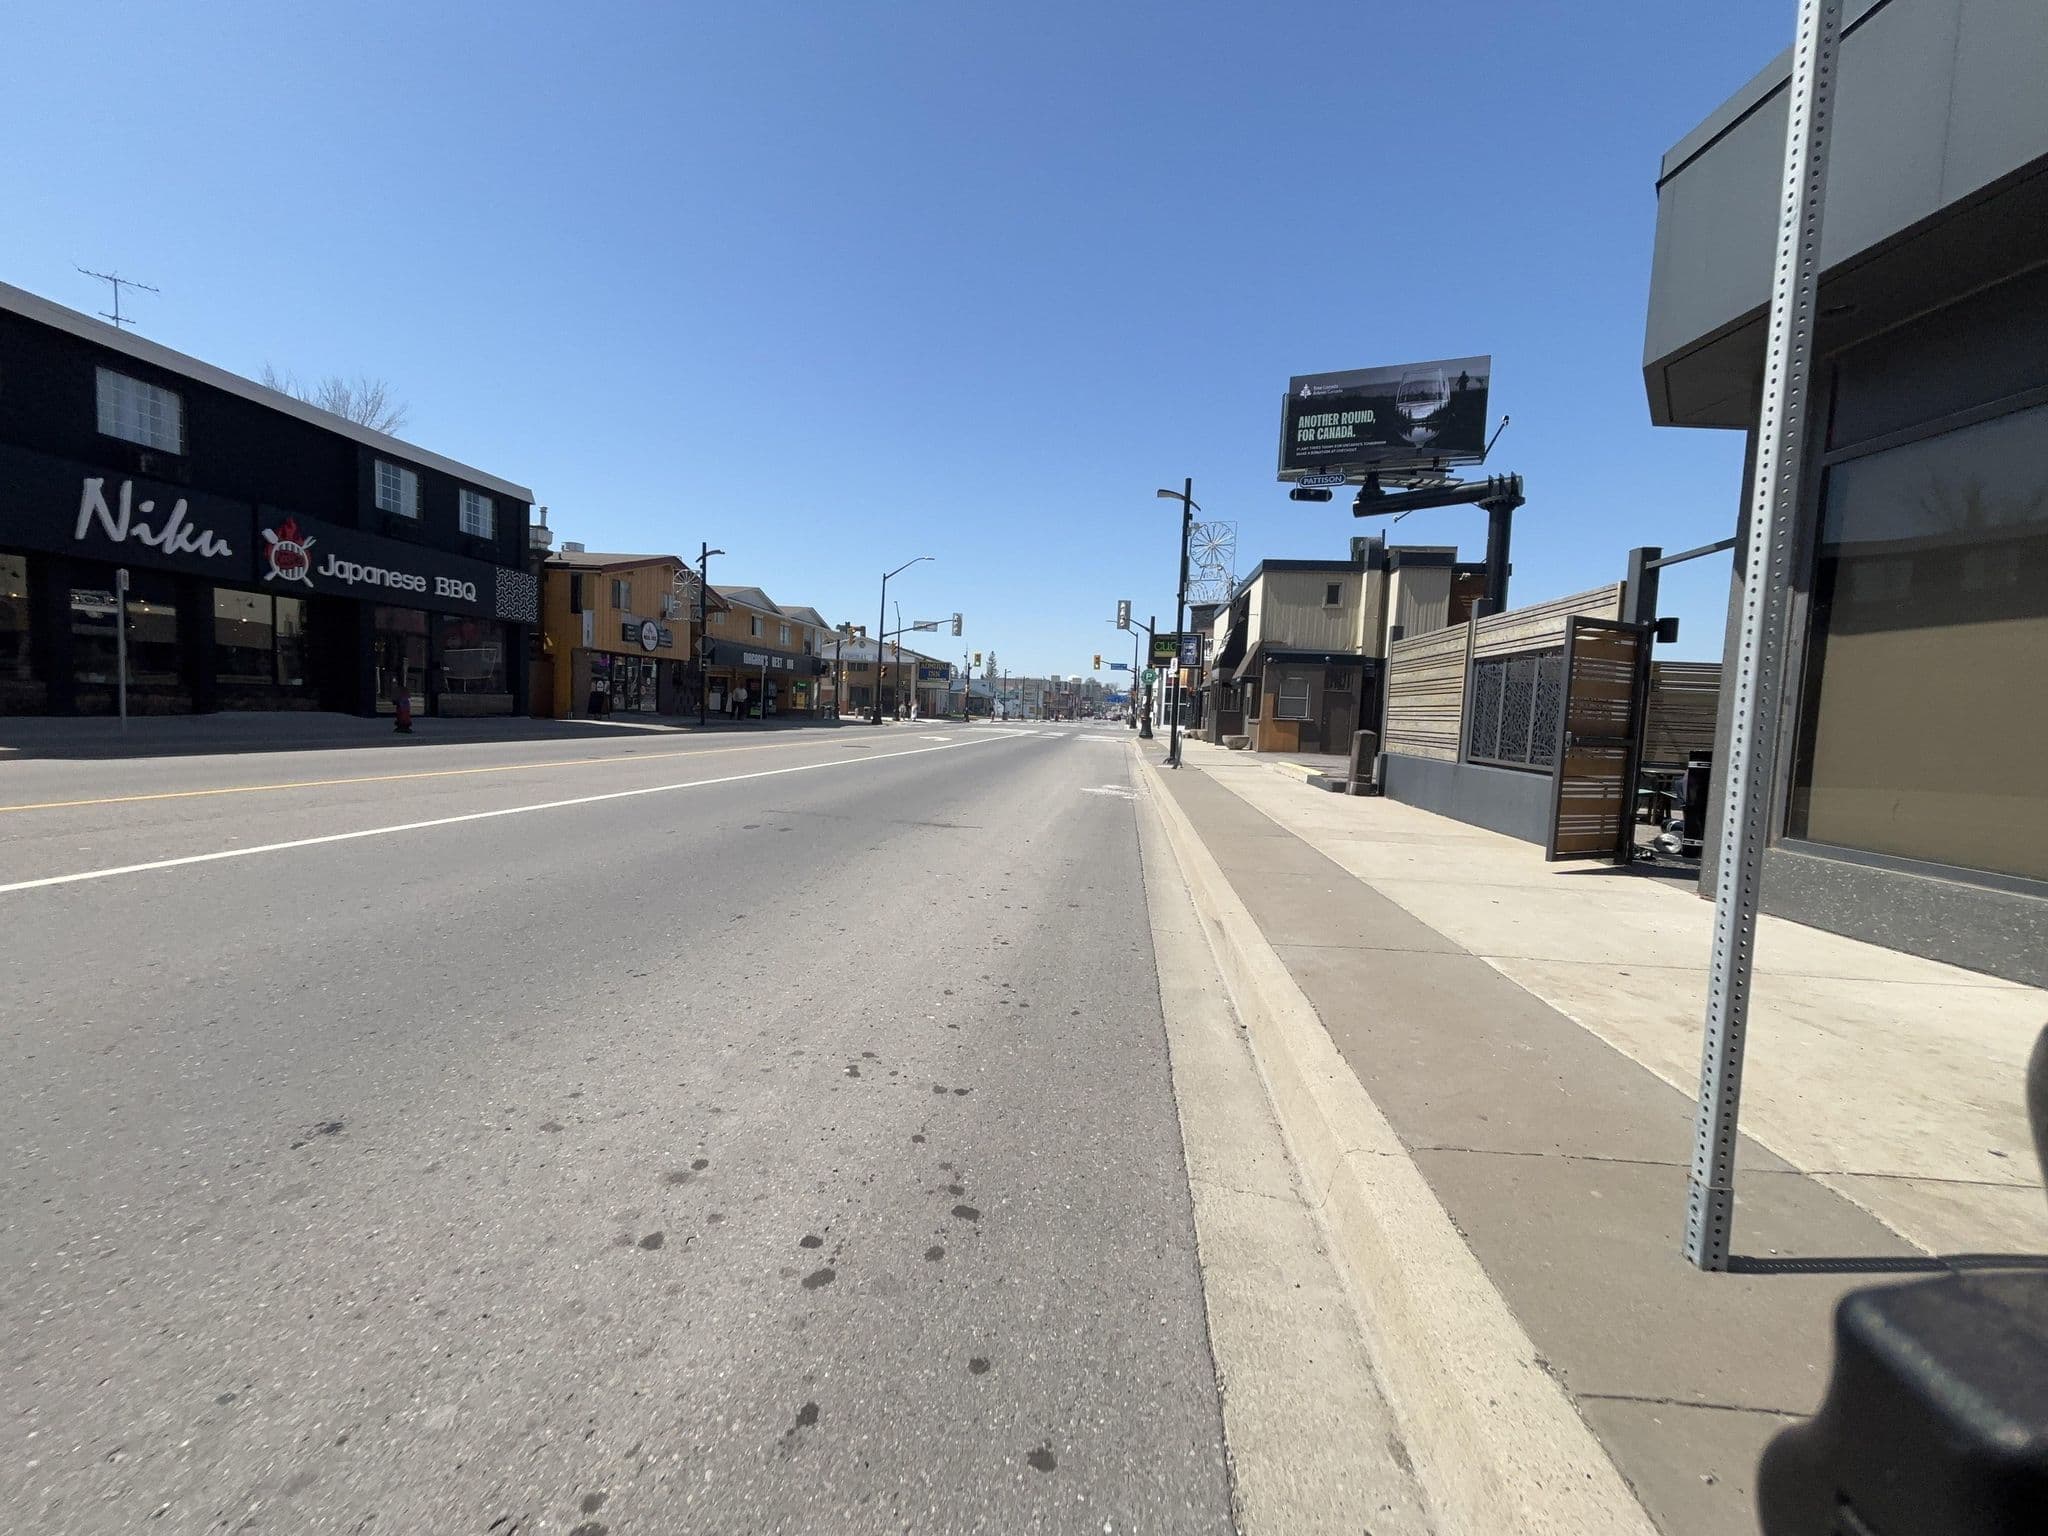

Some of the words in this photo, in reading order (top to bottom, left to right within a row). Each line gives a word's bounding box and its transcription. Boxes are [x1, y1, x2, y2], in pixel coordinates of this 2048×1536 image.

[1298, 413, 1339, 428] ANOTHER
[1341, 410, 1376, 425] ROUND,
[1297, 428, 1315, 442] FOR
[1317, 425, 1356, 440] CANADA.
[1303, 475, 1343, 485] PATTISON
[75, 478, 232, 557] Niku
[318, 554, 427, 592] Japanese
[434, 576, 478, 602] BBQ
